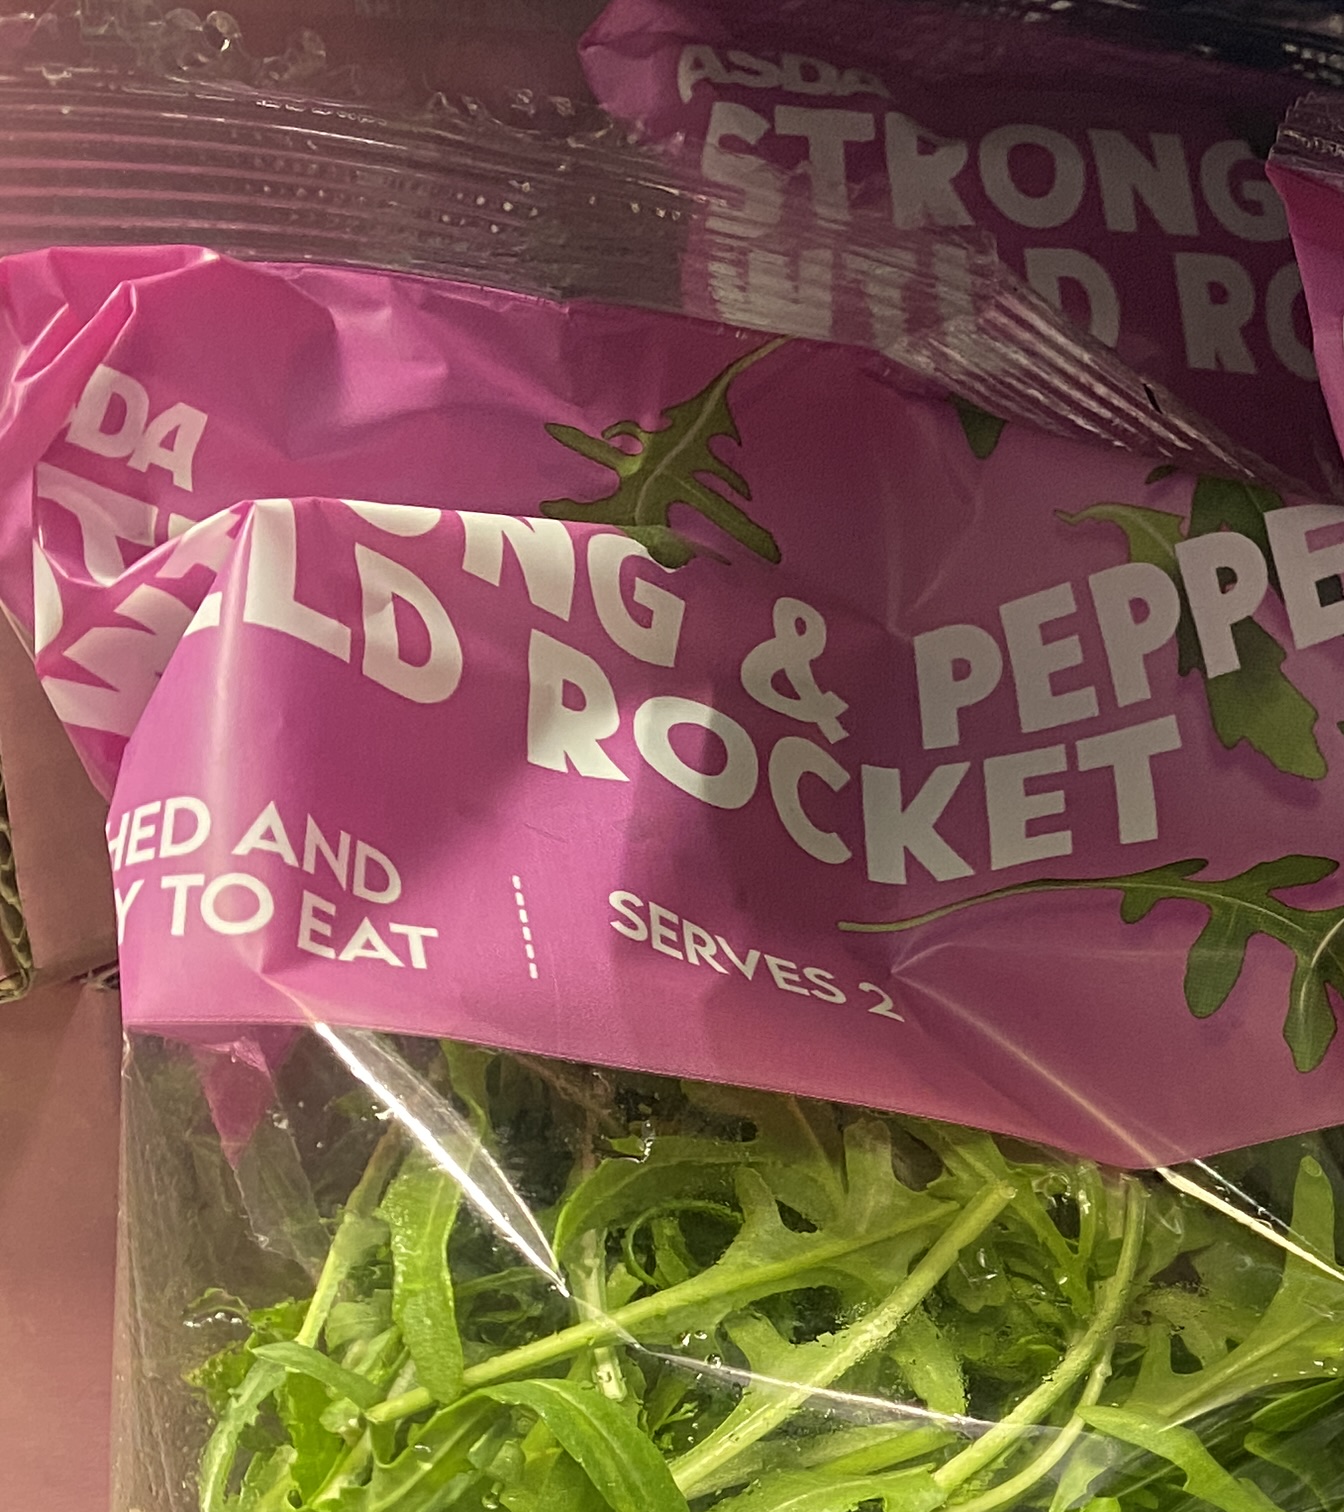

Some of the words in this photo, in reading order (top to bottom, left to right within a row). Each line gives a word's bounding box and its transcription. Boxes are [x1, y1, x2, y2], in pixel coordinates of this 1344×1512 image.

[678, 45, 892, 102] ASDA
[701, 100, 1292, 243] STRONG
[65, 363, 208, 492] DA
[740, 597, 850, 745] &
[528, 629, 1182, 886] ROCKET
[106, 796, 211, 871] HED
[231, 800, 401, 904] AND
[161, 873, 274, 936] TO
[298, 890, 439, 970] EAT
[608, 890, 847, 1004] SERVES
[858, 982, 905, 1023] 2
